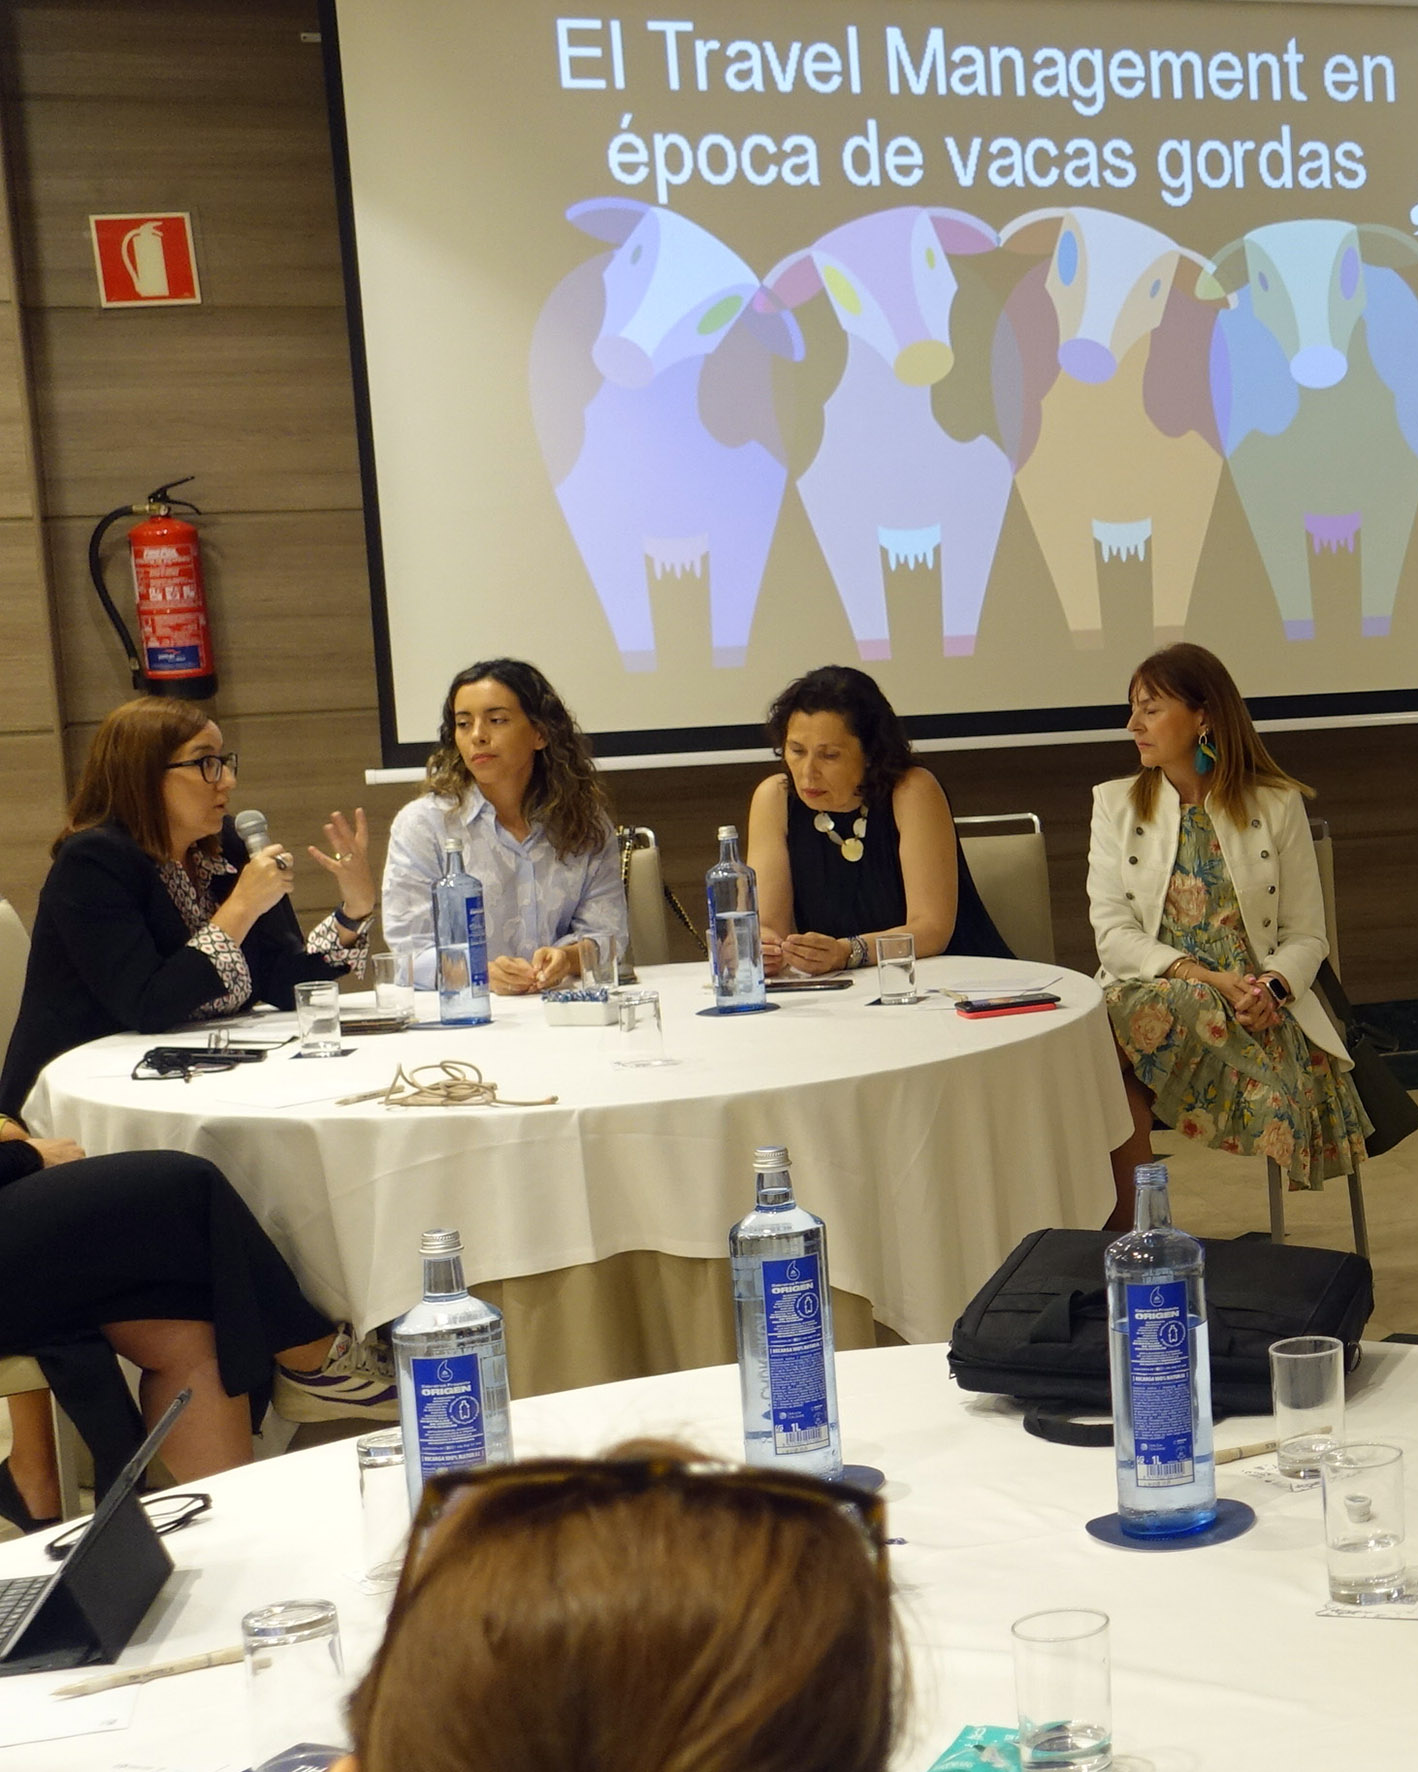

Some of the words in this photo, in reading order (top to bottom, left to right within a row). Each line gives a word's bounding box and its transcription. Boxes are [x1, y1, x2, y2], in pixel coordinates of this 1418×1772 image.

[556, 18, 626, 90] El
[646, 20, 861, 95] Travel
[885, 26, 1308, 116] Management
[1323, 52, 1397, 103] en
[607, 112, 821, 205] época
[842, 118, 924, 187] de
[945, 136, 1137, 188] vacas
[1157, 125, 1368, 207] gordas
[771, 1282, 814, 1294] ORIGEN
[1134, 1310, 1180, 1320] ORIGEN
[421, 1384, 472, 1396] ORIGEN
